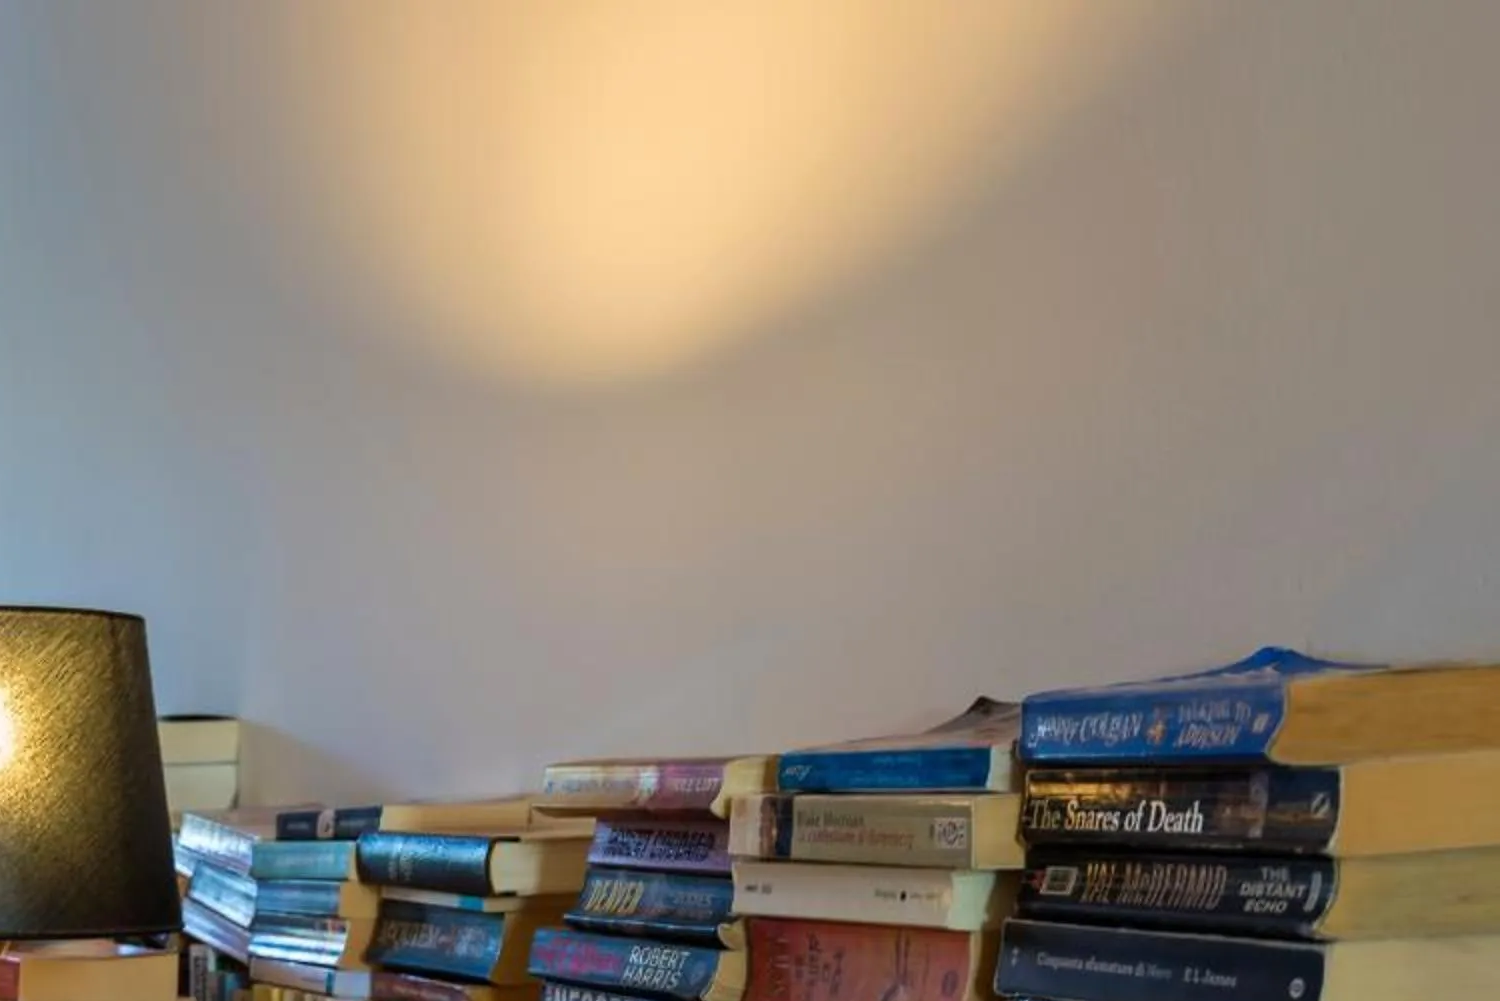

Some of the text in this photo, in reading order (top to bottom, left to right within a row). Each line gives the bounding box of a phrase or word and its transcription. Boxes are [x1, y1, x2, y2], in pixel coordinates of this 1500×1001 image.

[1029, 799, 1204, 833] The Snares of Death
[1261, 867, 1290, 881] THE
[1240, 881, 1308, 899] DISTANT
[1243, 899, 1289, 914] ECHO
[628, 945, 691, 969] ROBERT
[620, 966, 683, 990] HARRIS
